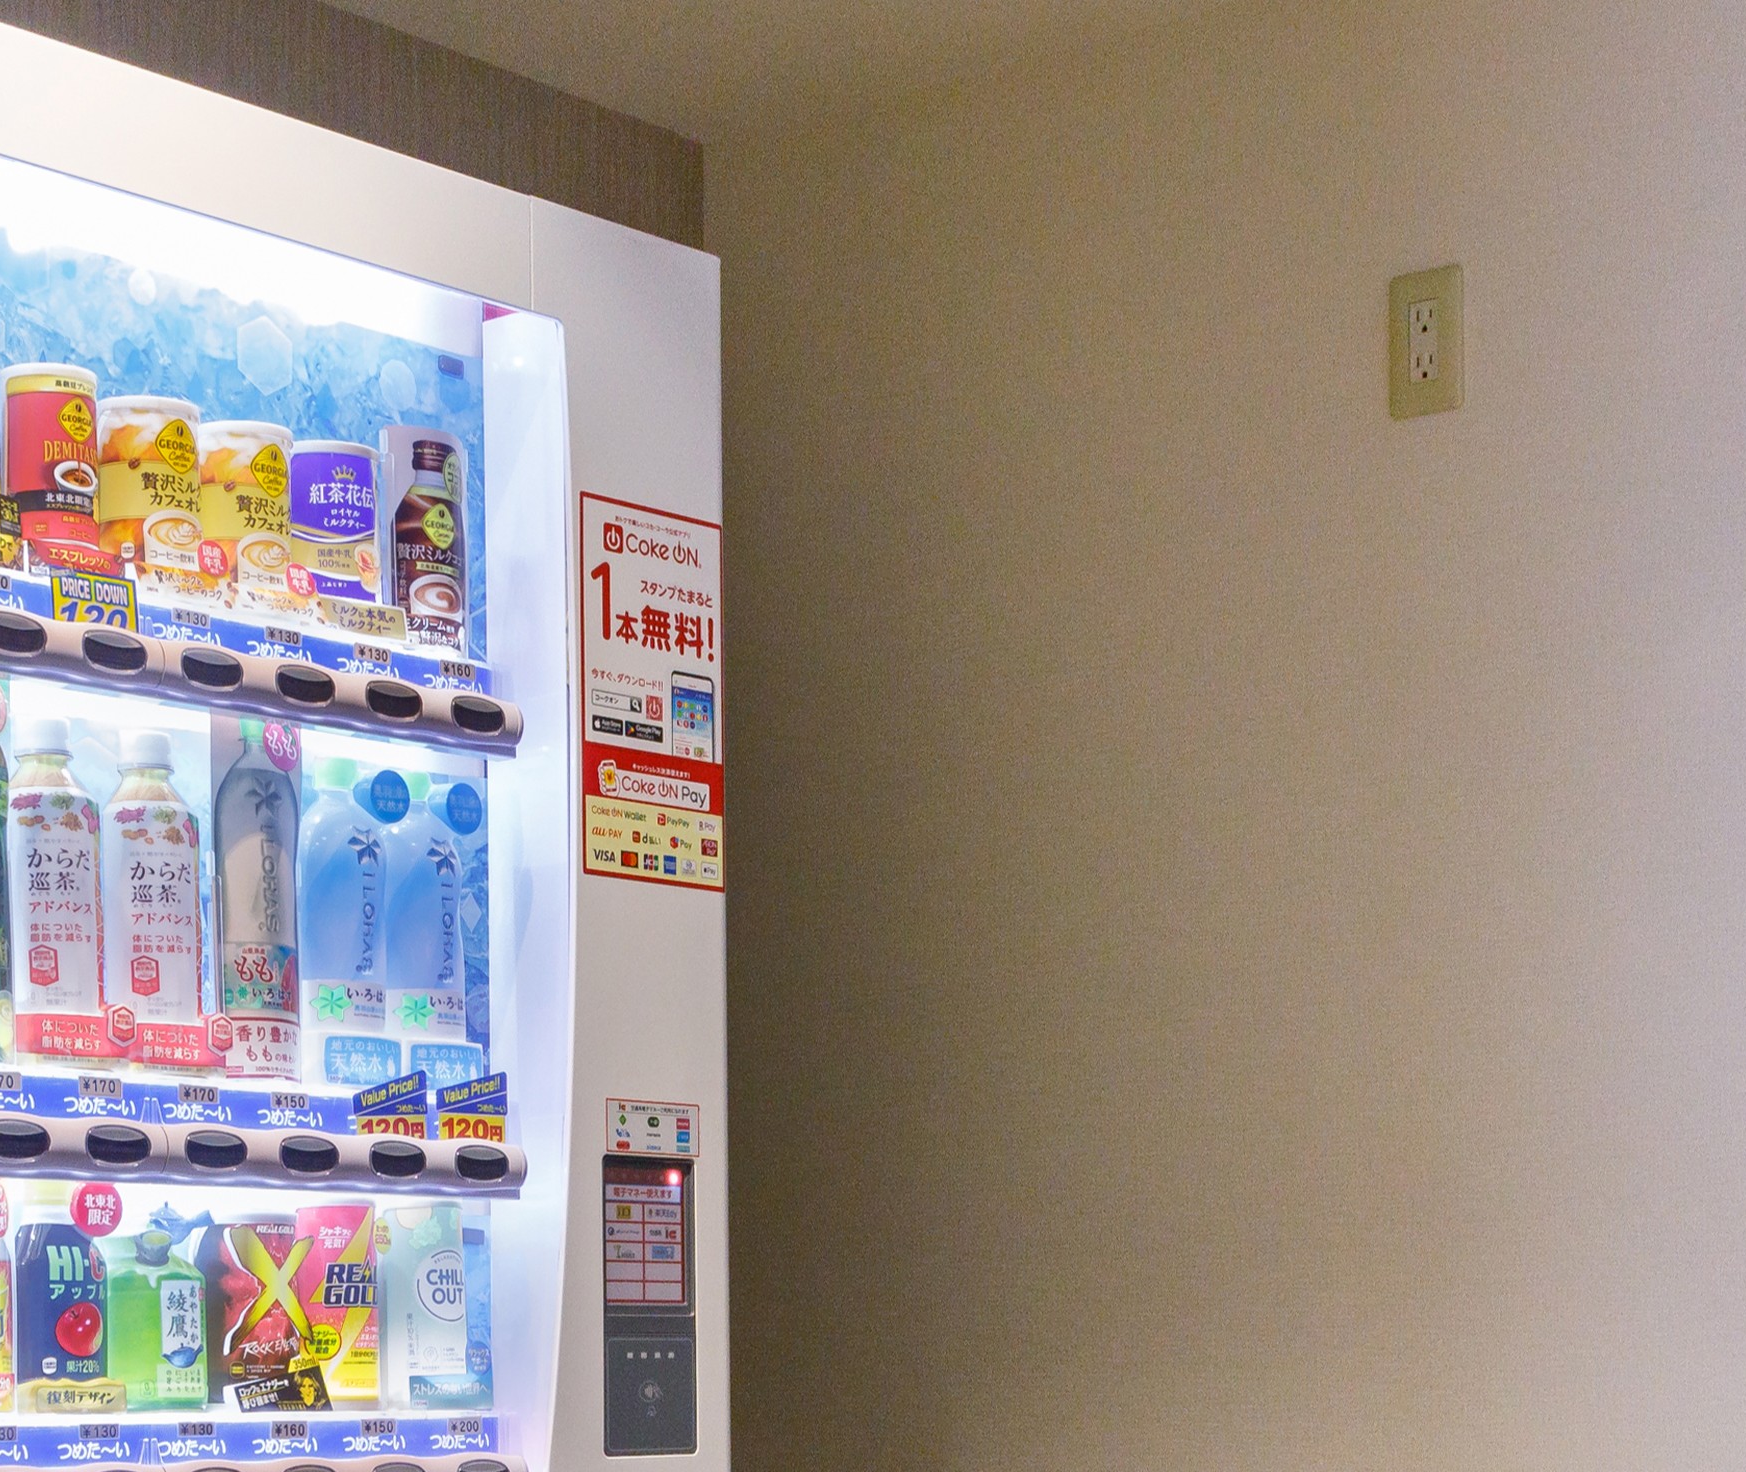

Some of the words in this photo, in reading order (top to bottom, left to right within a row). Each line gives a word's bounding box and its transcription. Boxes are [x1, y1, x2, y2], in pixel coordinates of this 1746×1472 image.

[309, 483, 374, 509] 紅茶花伝
[626, 533, 669, 560] Coke
[673, 542, 699, 568] ON
[50, 549, 110, 569] エスプレッソの
[61, 577, 91, 600] PRICE
[96, 584, 128, 606] DOWN
[640, 580, 713, 608] スタンプたまると
[267, 629, 299, 643] ¥130
[622, 776, 655, 795] Coke
[658, 781, 678, 799] ON
[682, 786, 707, 808] Pay
[27, 849, 90, 871] からだ
[593, 849, 615, 862] VISA
[130, 861, 191, 885] からだ
[29, 901, 93, 915] アドバンス
[30, 923, 82, 933] 体についた
[132, 913, 194, 927] アドバンス
[42, 1020, 99, 1036] 体についた
[42, 1036, 102, 1051] 脂肪を減らす
[142, 1045, 201, 1062] 脂肪を減らす
[330, 1053, 383, 1073] 天然水
[82, 1080, 116, 1094] ¥170
[183, 1087, 215, 1101] ¥170
[275, 1095, 305, 1108] ¥150
[85, 1194, 116, 1210] 北東北
[88, 1209, 113, 1225] 限定
[432, 1287, 463, 1304] OUT
[168, 1291, 189, 1338] 綾鷹
[47, 1390, 115, 1405] 復刻デザイン
[365, 1421, 394, 1434] ¥150
[451, 1421, 479, 1433] ¥200
